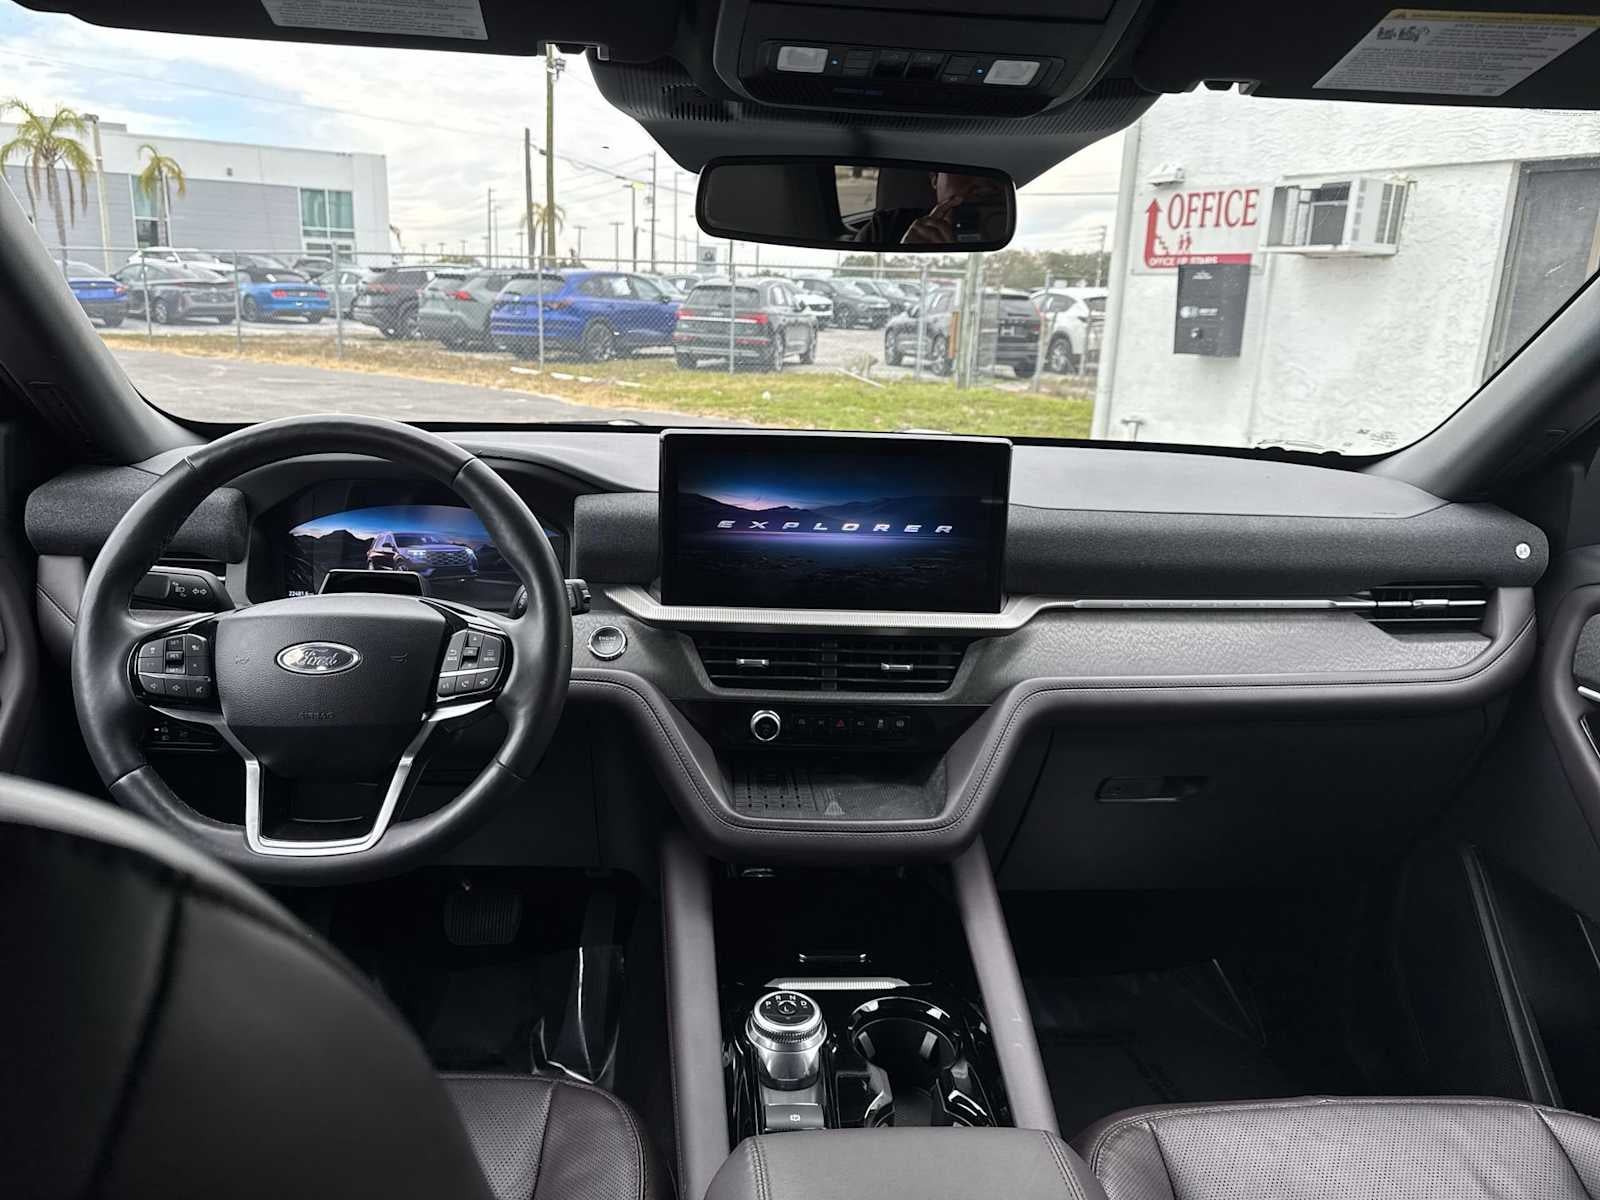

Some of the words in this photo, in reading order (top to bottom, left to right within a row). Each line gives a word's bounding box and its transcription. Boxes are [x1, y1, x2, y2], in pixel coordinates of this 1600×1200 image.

[1168, 188, 1259, 230] OFFICE
[1149, 257, 1174, 266] OFFICE
[716, 520, 953, 535] EXPLORER
[296, 650, 338, 666] Ford
